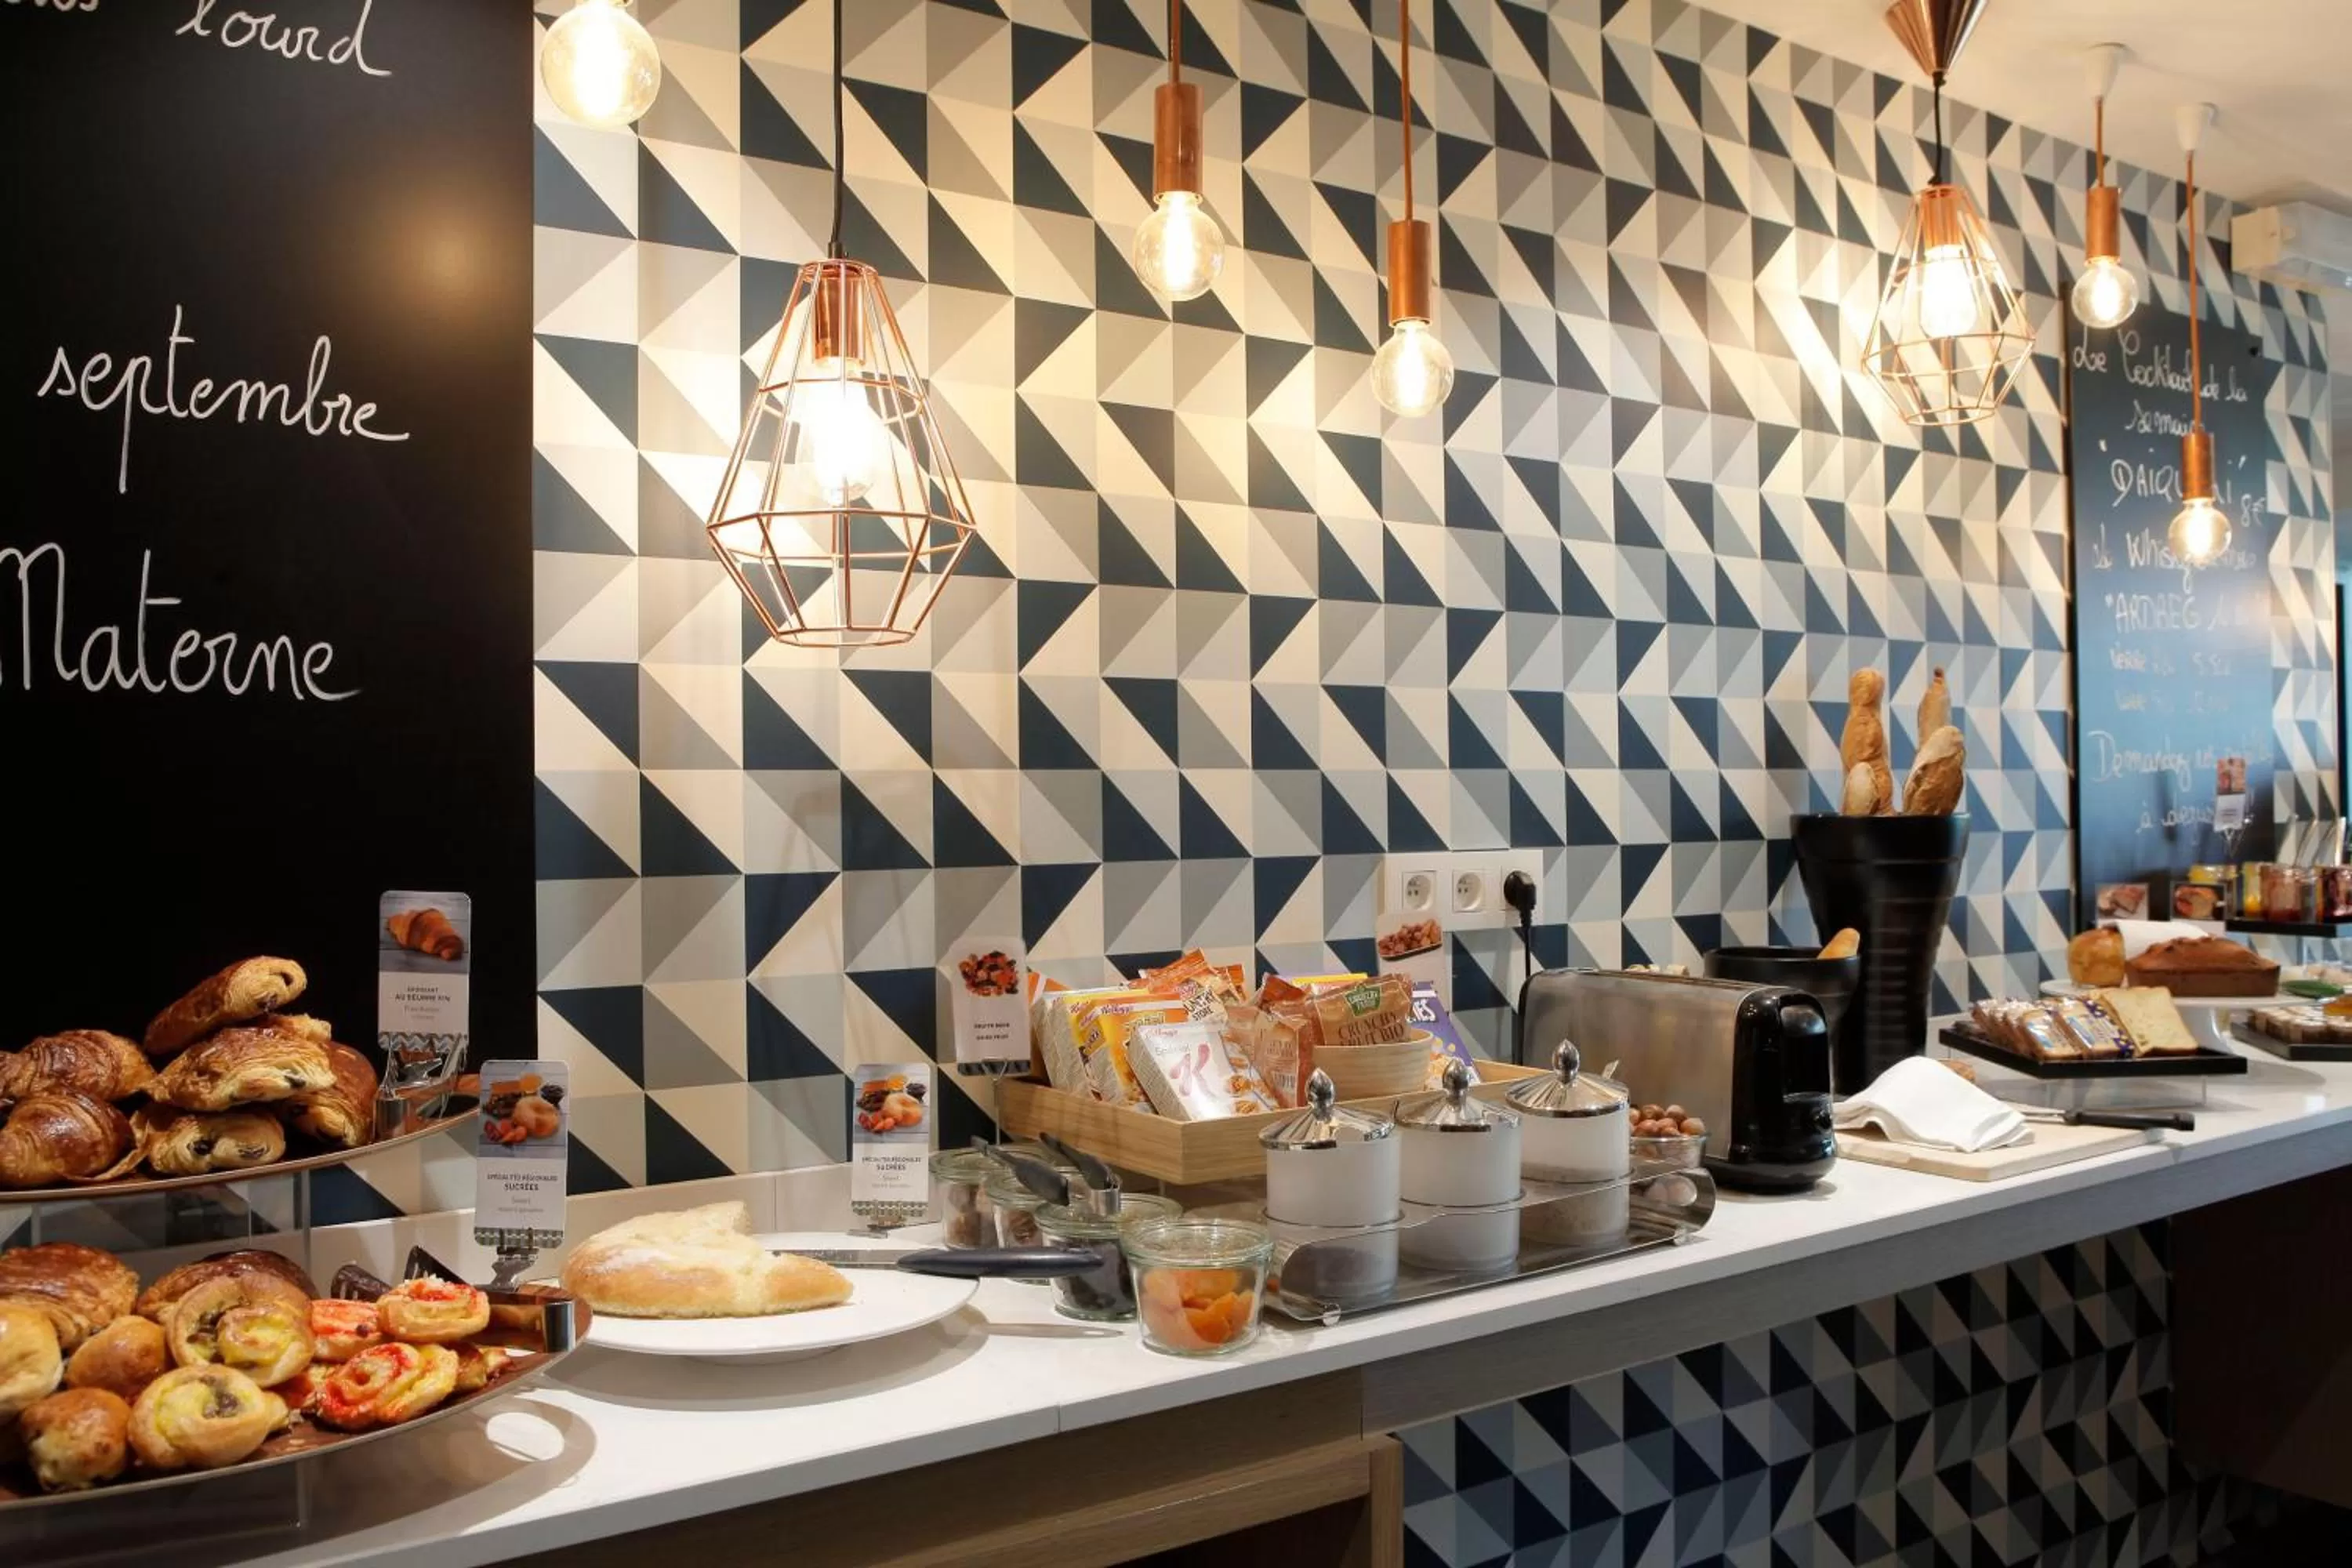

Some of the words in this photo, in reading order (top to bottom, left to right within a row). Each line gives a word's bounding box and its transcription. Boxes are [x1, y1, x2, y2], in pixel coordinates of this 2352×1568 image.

[37, 304, 410, 494] septembre
[2125, 526, 2194, 594] Whisy
[0, 543, 363, 702] Materne
[1380, 1022, 1404, 1043] BIO
